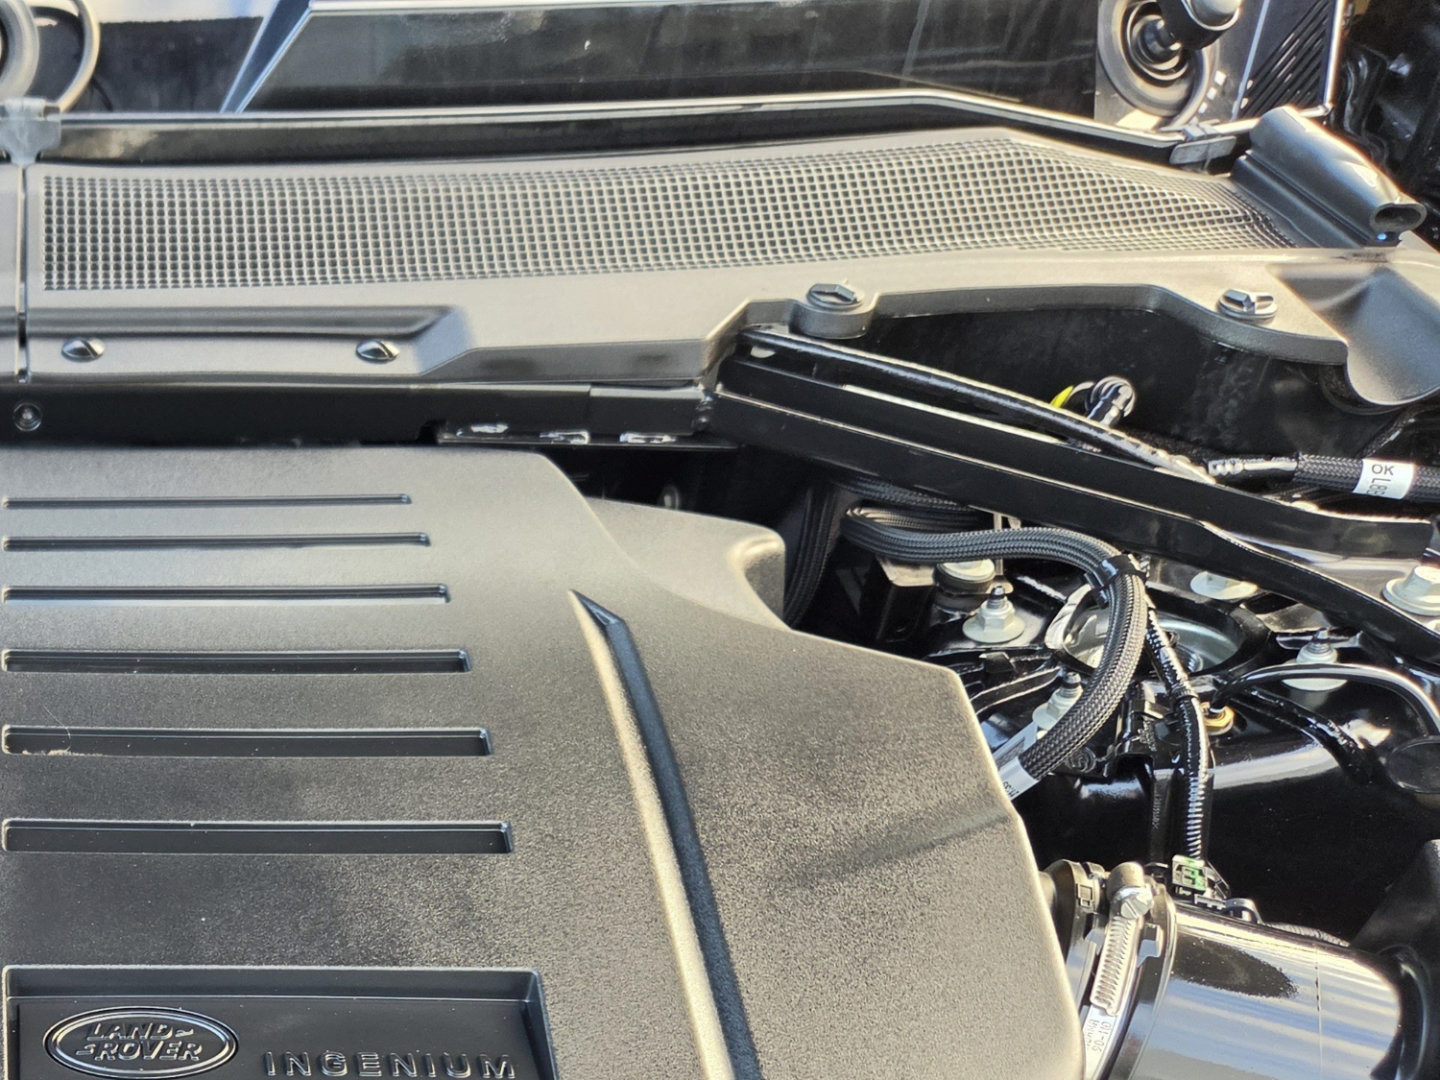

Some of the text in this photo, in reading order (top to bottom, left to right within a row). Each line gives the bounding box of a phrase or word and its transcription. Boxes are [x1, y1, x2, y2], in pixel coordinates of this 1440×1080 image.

[1371, 463, 1394, 476] OK
[88, 1022, 172, 1041] LAND
[93, 1040, 203, 1061] ROVER
[263, 1050, 517, 1079] INGENIUM
